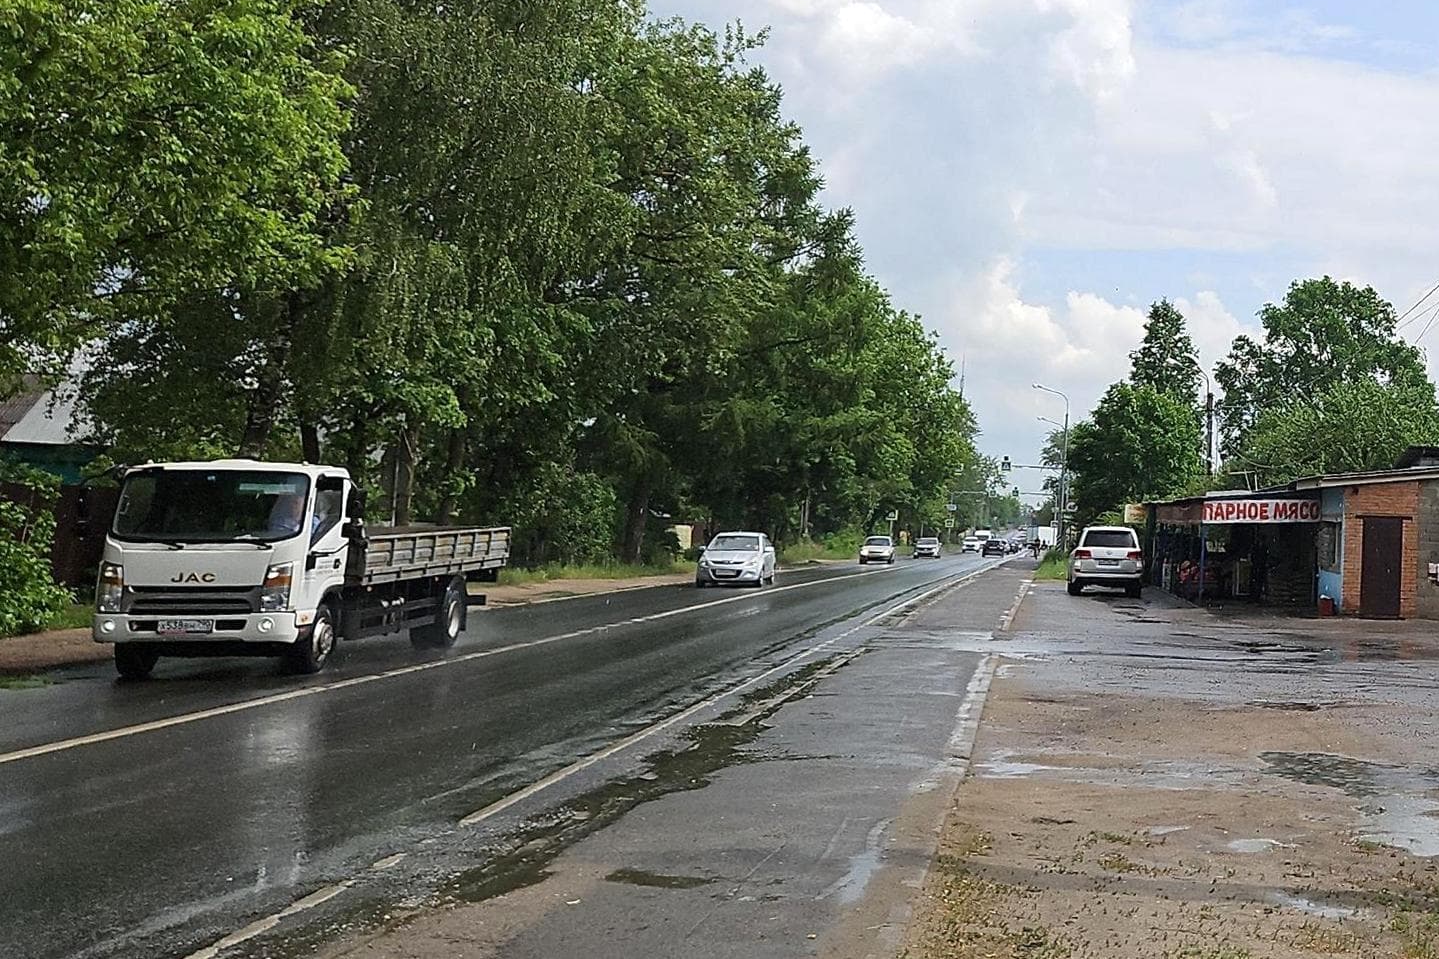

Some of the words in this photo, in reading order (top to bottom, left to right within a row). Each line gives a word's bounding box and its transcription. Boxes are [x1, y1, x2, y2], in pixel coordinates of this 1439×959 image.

[1203, 503, 1269, 522] ПАРНОЕ
[1273, 502, 1320, 520] МЯСО
[170, 572, 216, 583] JAC
